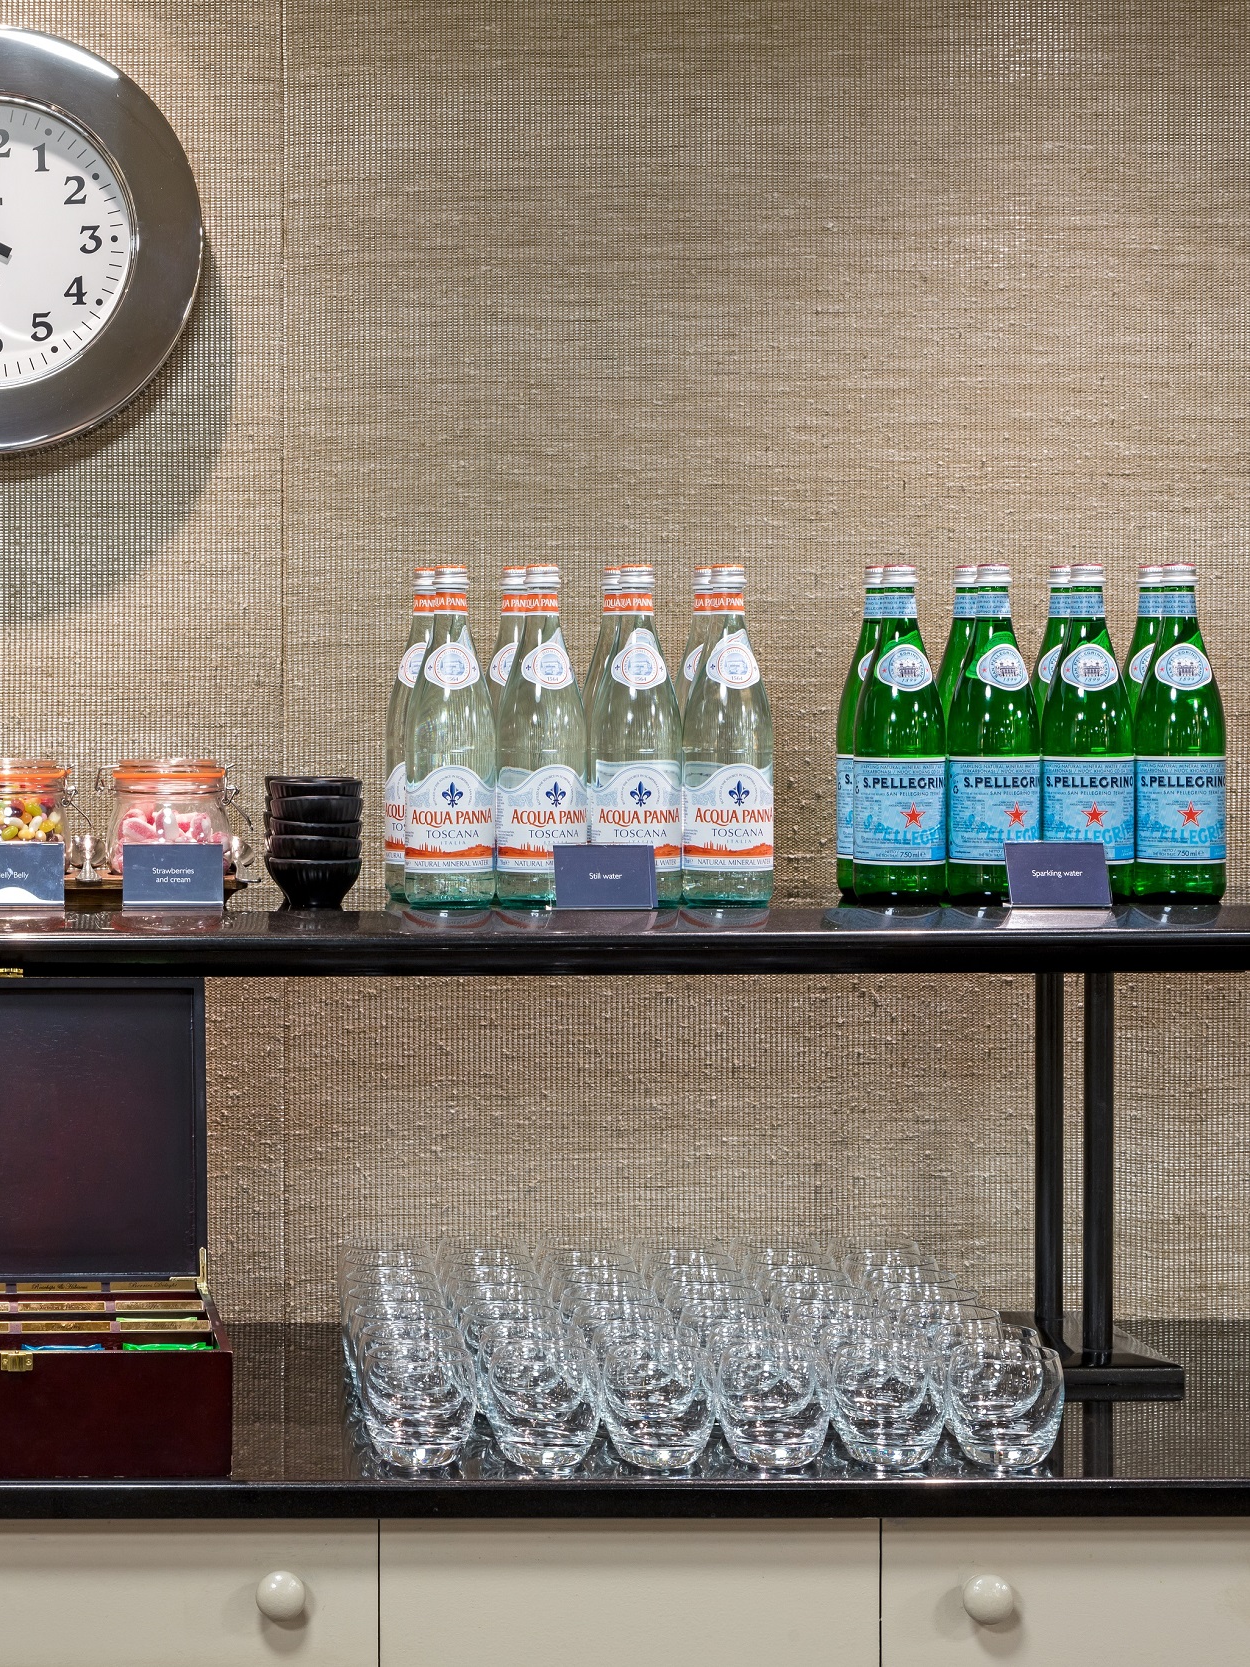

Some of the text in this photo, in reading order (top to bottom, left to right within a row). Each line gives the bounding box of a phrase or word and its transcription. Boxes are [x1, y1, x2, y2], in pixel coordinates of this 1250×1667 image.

[33, 142, 50, 172] 1
[64, 175, 87, 205] 2
[79, 225, 102, 254] 3
[64, 276, 88, 306] 4
[31, 312, 53, 342] 5
[863, 777, 945, 789] S.PELLEGRIN
[964, 777, 1038, 788] S.PELLEGRI
[1046, 776, 1133, 788] S.PELLEGRINO
[412, 810, 453, 828] ACQUA
[456, 808, 492, 824] PANNA
[511, 809, 556, 828] ACQUA
[599, 808, 680, 827] ACQUA PANNA
[695, 808, 740, 826] ACQUA
[426, 830, 479, 839] TOSCANA
[529, 830, 579, 838] TOSCANA
[614, 829, 667, 838] TOSCANA
[712, 828, 763, 837] TOSCANA
[13, 872, 29, 880] Belly
[1032, 870, 1062, 878] Sparkling
